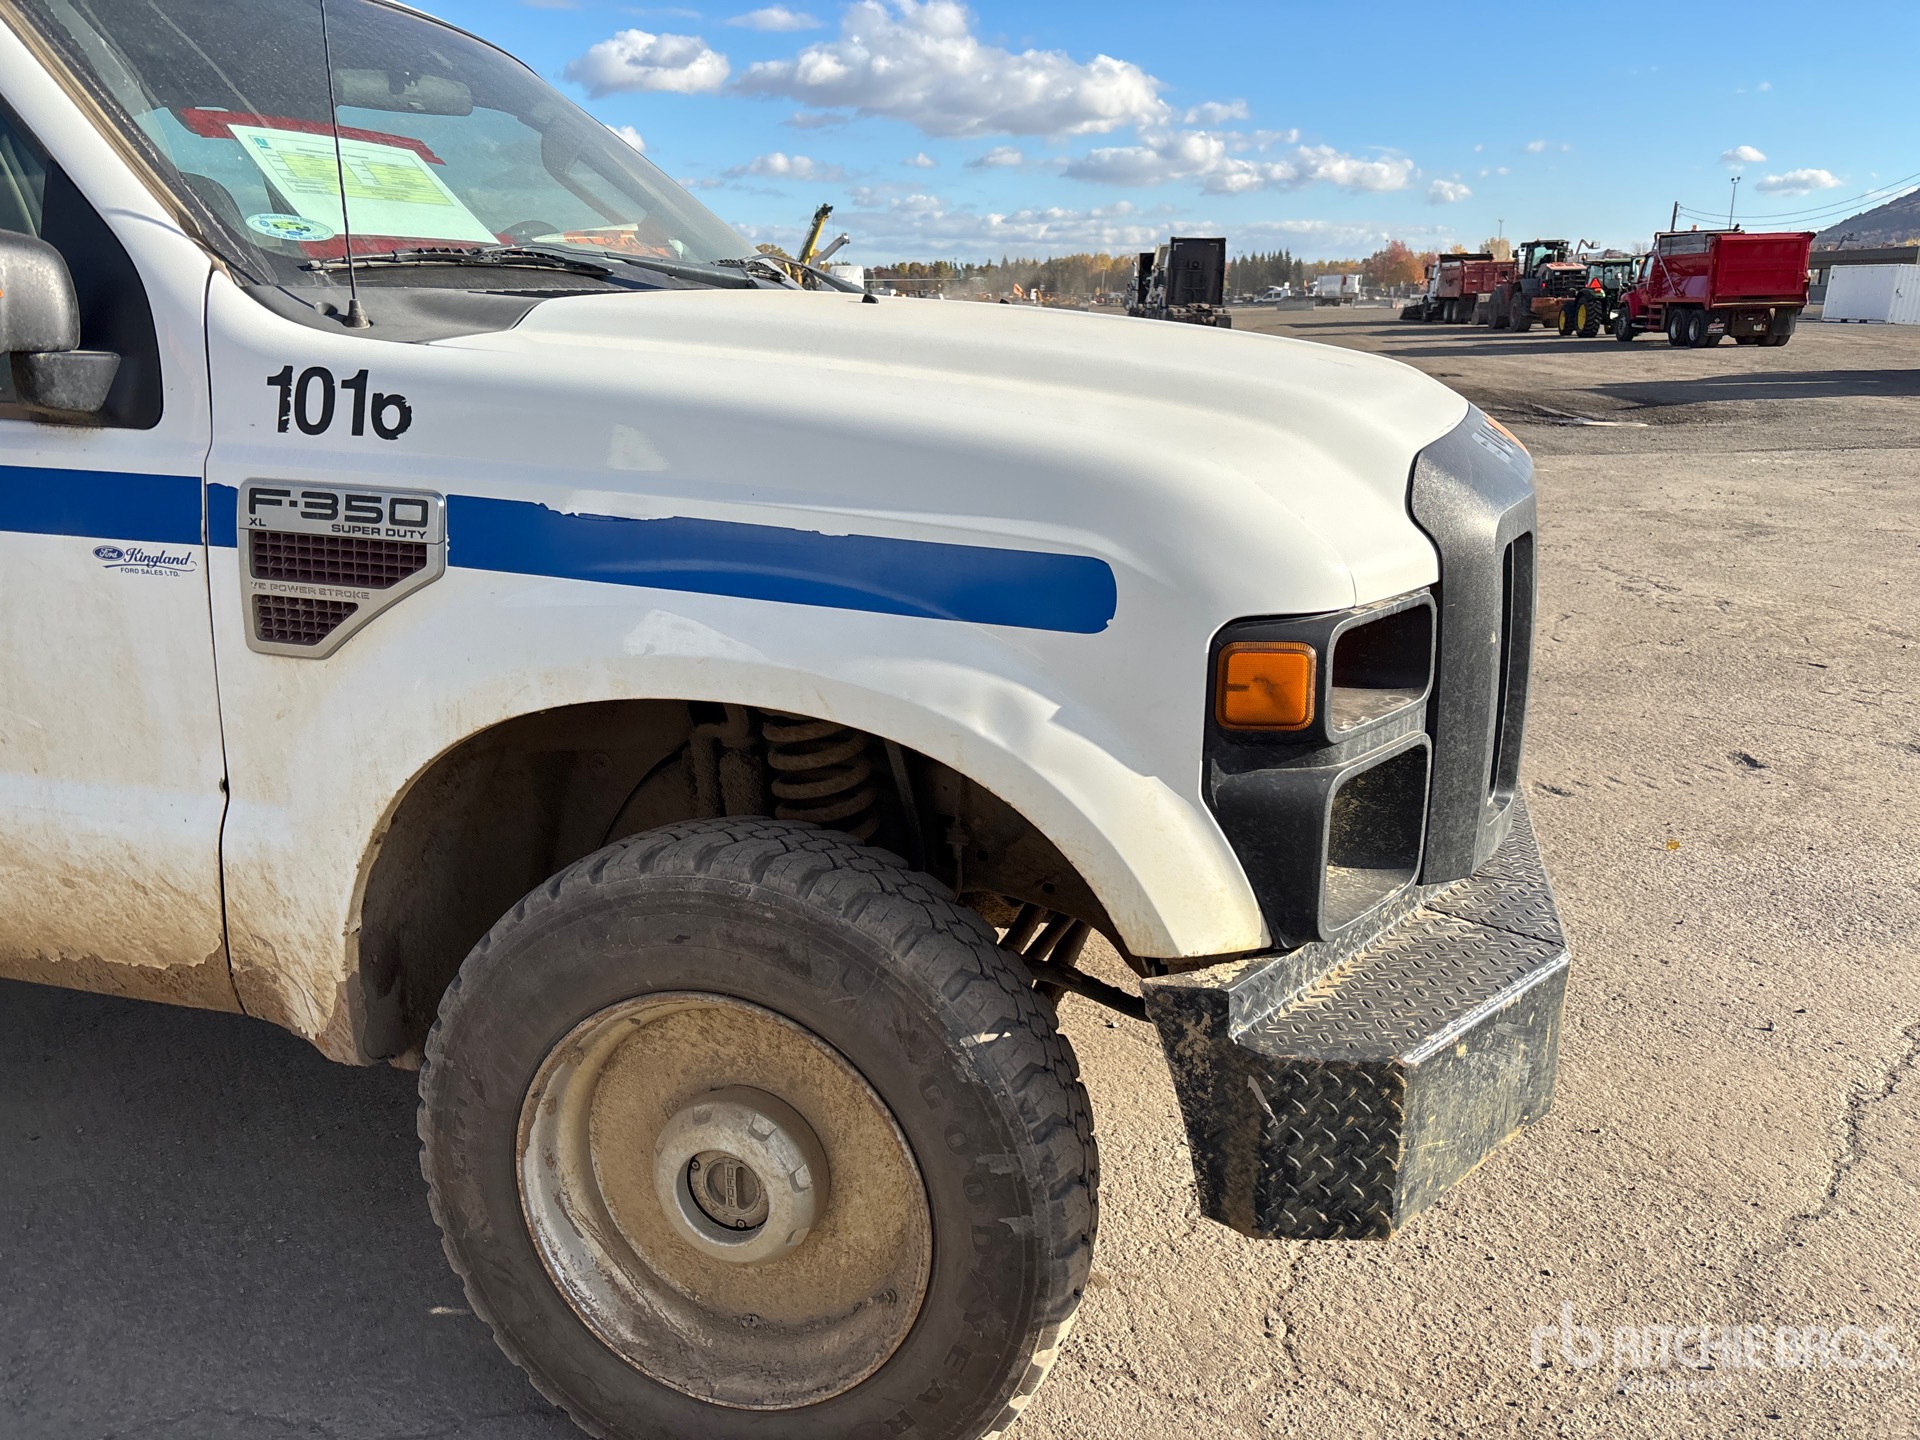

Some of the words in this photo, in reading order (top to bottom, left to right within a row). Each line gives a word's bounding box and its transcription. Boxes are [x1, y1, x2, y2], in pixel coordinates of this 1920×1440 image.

[248, 487, 428, 528] F-350
[248, 517, 267, 527] XL
[331, 524, 381, 537] SUPER
[385, 528, 428, 540] DUTY
[123, 547, 192, 568] Kingland
[141, 568, 163, 576] SALES
[270, 583, 317, 595] POWER
[318, 588, 371, 600] STROKE
[726, 1166, 736, 1208] FORD
